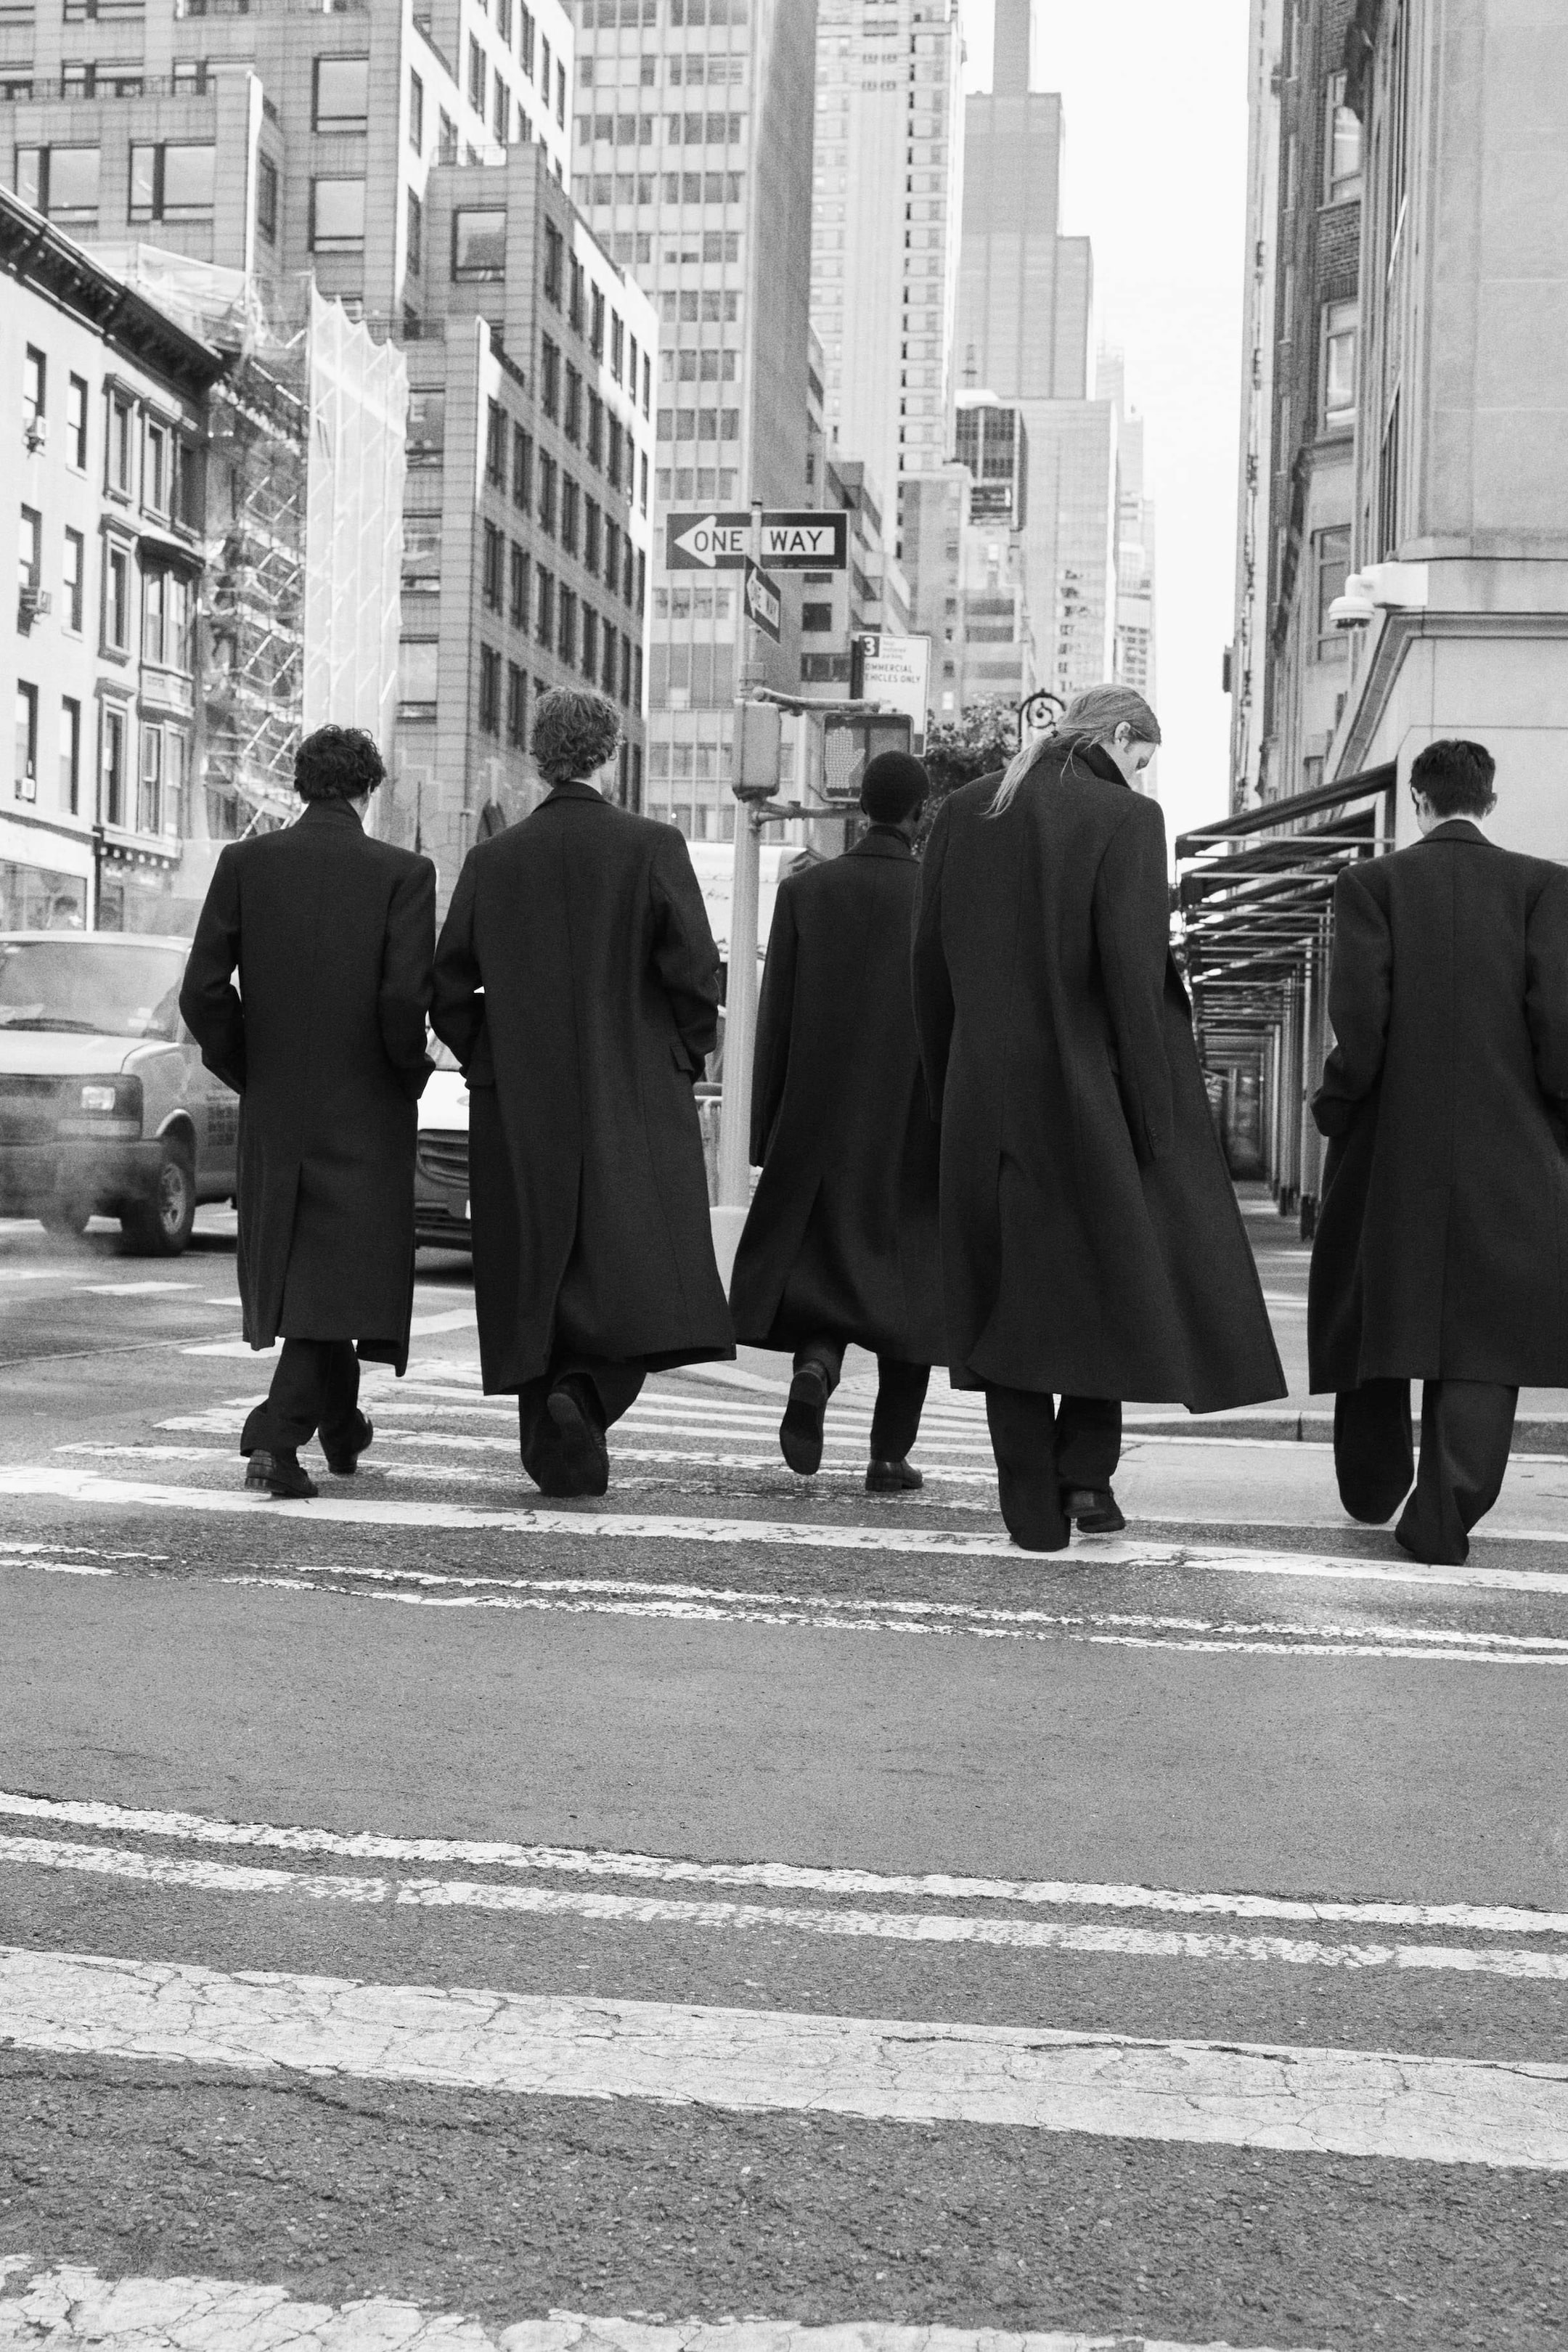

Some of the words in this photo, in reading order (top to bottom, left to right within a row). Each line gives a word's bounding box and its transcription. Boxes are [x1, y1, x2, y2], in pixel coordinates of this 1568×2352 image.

[694, 530, 743, 552] ONE
[770, 530, 823, 552] WAY
[864, 637, 875, 656] 3
[864, 663, 912, 674] OMMERCIAL
[865, 673, 898, 683] EHICLES
[900, 674, 921, 685] ONLY
